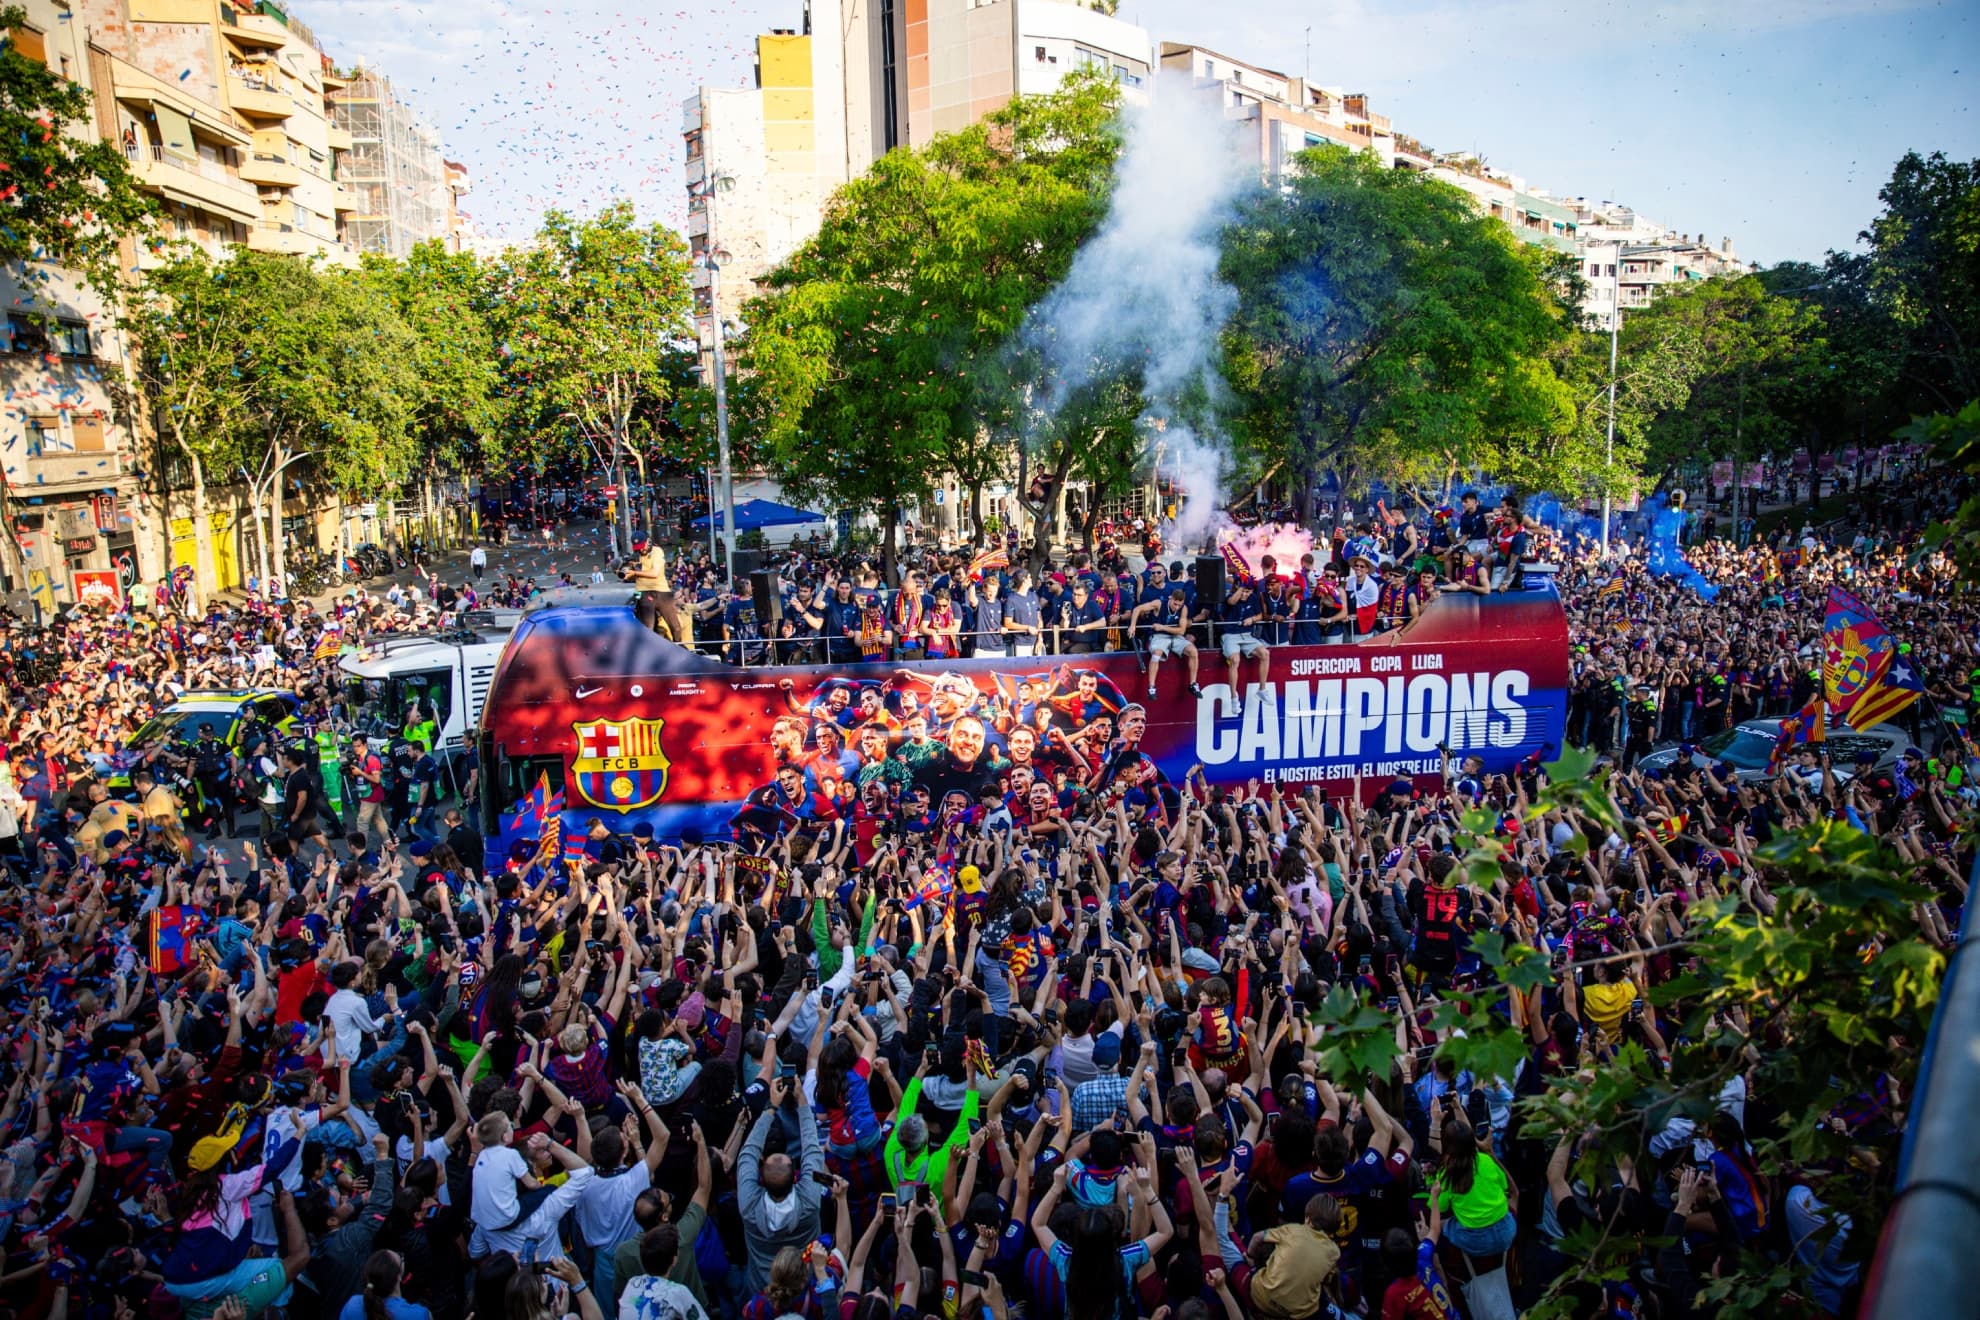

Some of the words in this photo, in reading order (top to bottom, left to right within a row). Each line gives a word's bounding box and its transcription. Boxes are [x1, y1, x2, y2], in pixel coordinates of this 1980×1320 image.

[102, 497, 113, 528] CLUB
[1291, 657, 1361, 676] SUPERCOPA
[1370, 655, 1402, 672] COPA
[1412, 654, 1443, 671] LLIGA
[1196, 670, 1530, 765] CAMPIONS
[1735, 725, 1777, 742] CUPR
[602, 757, 639, 770] FCB
[1264, 768, 1277, 784] EL
[1279, 765, 1324, 783] NOSTRE
[1326, 763, 1355, 780] ESTIL
[1362, 762, 1374, 778] EL
[1377, 760, 1420, 777] NOSTRE
[1423, 757, 1463, 774] LLEAT
[968, 911, 982, 925] 10
[1424, 893, 1458, 922] 19
[1214, 1016, 1232, 1047] 3
